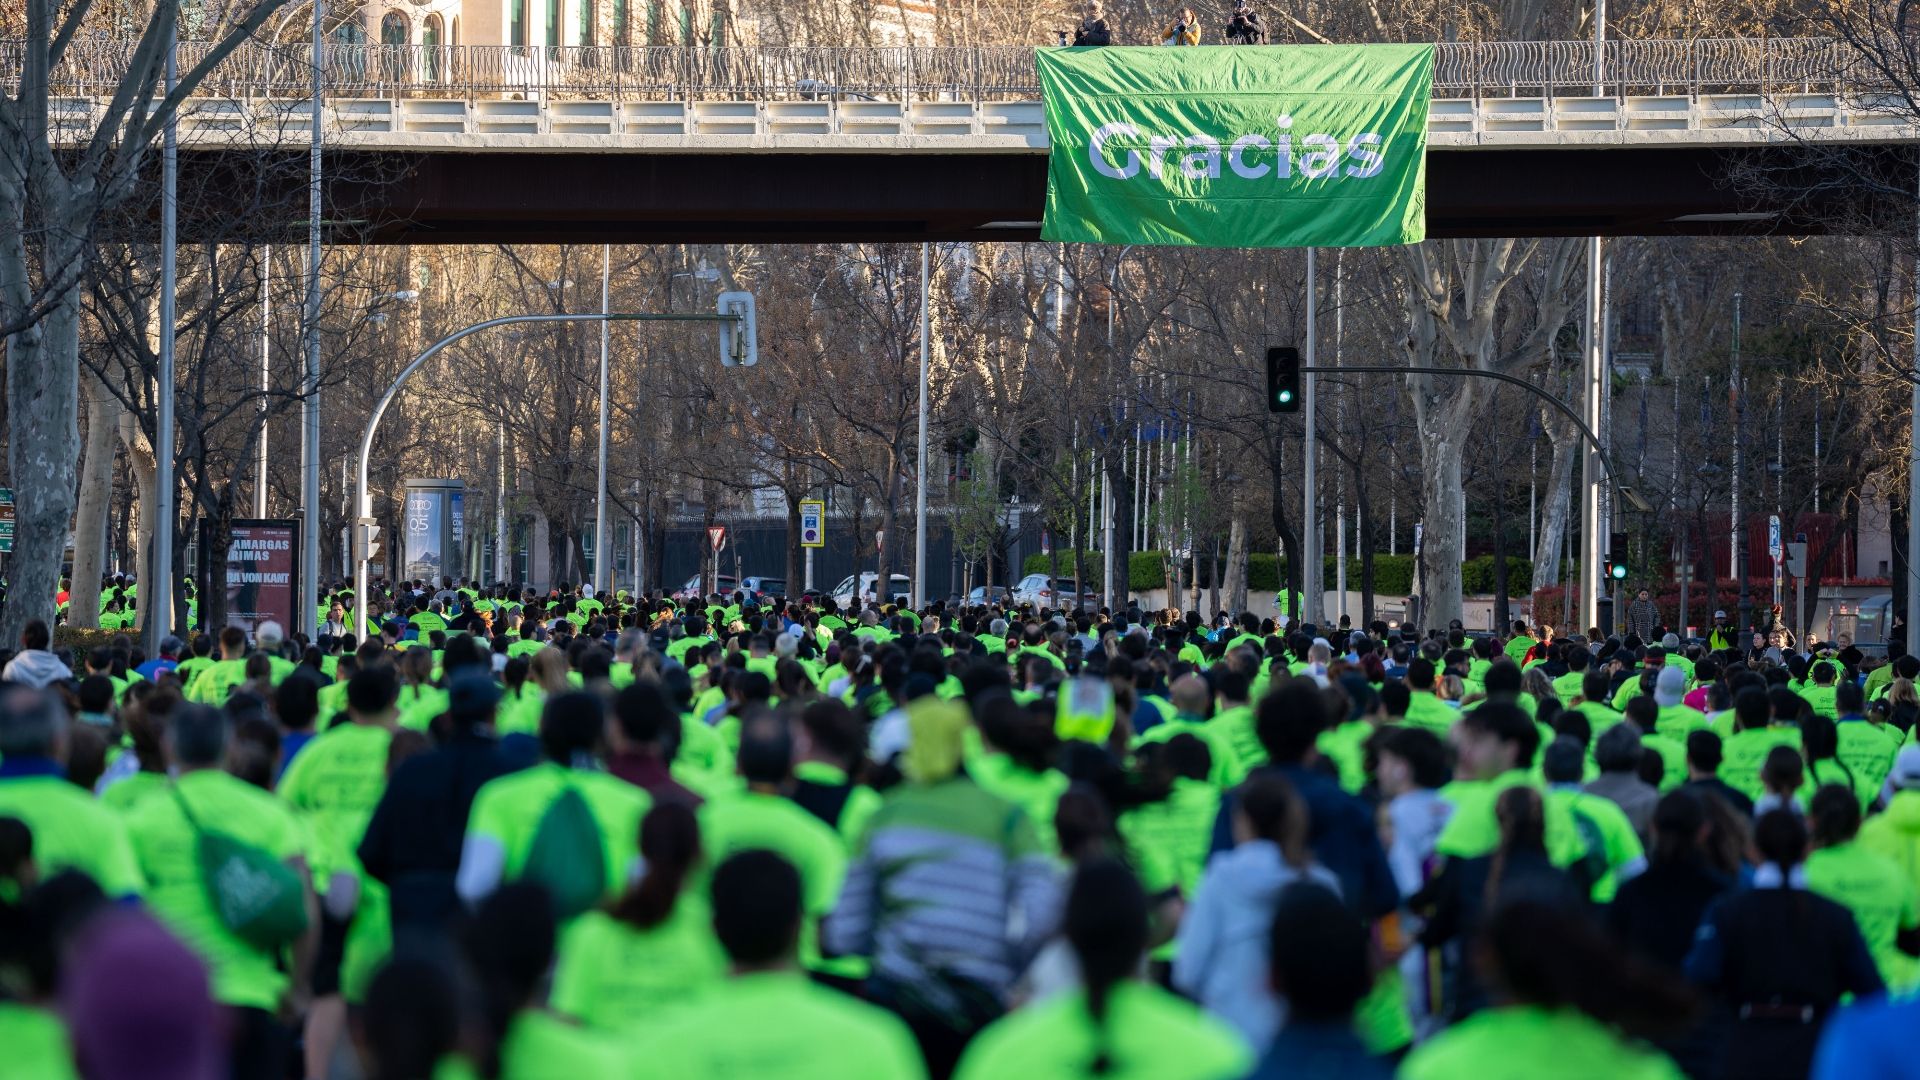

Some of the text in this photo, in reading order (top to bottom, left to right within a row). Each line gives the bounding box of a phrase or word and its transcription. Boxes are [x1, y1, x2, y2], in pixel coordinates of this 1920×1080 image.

[1088, 114, 1385, 180] Gracias
[233, 539, 290, 550] AMARGAS
[228, 550, 270, 561] RIMAS
[241, 572, 262, 583] VON
[263, 572, 290, 584] KANT
